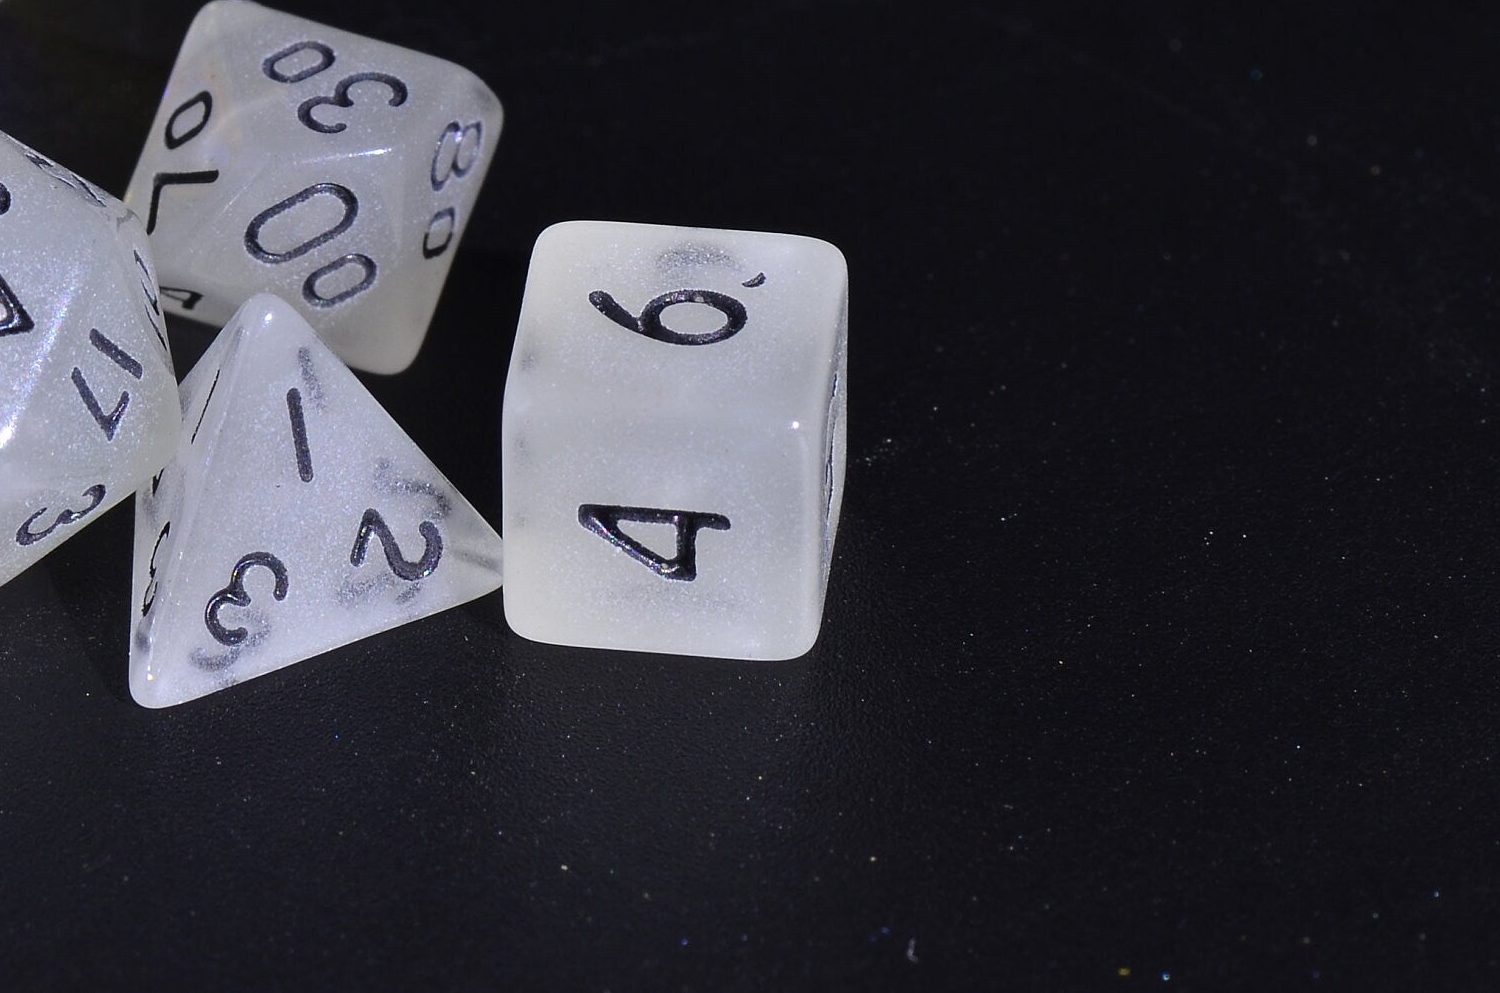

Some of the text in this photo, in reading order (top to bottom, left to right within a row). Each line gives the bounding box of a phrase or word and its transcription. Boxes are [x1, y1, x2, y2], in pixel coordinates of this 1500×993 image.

[262, 40, 409, 135] 30
[146, 90, 220, 236] 70
[430, 120, 484, 260] 80
[243, 182, 378, 308] 00
[72, 328, 144, 442] 17
[286, 387, 315, 483] 1
[15, 483, 107, 547] 3
[349, 507, 444, 582] 2
[577, 502, 732, 583] 4
[204, 550, 289, 647] 3
